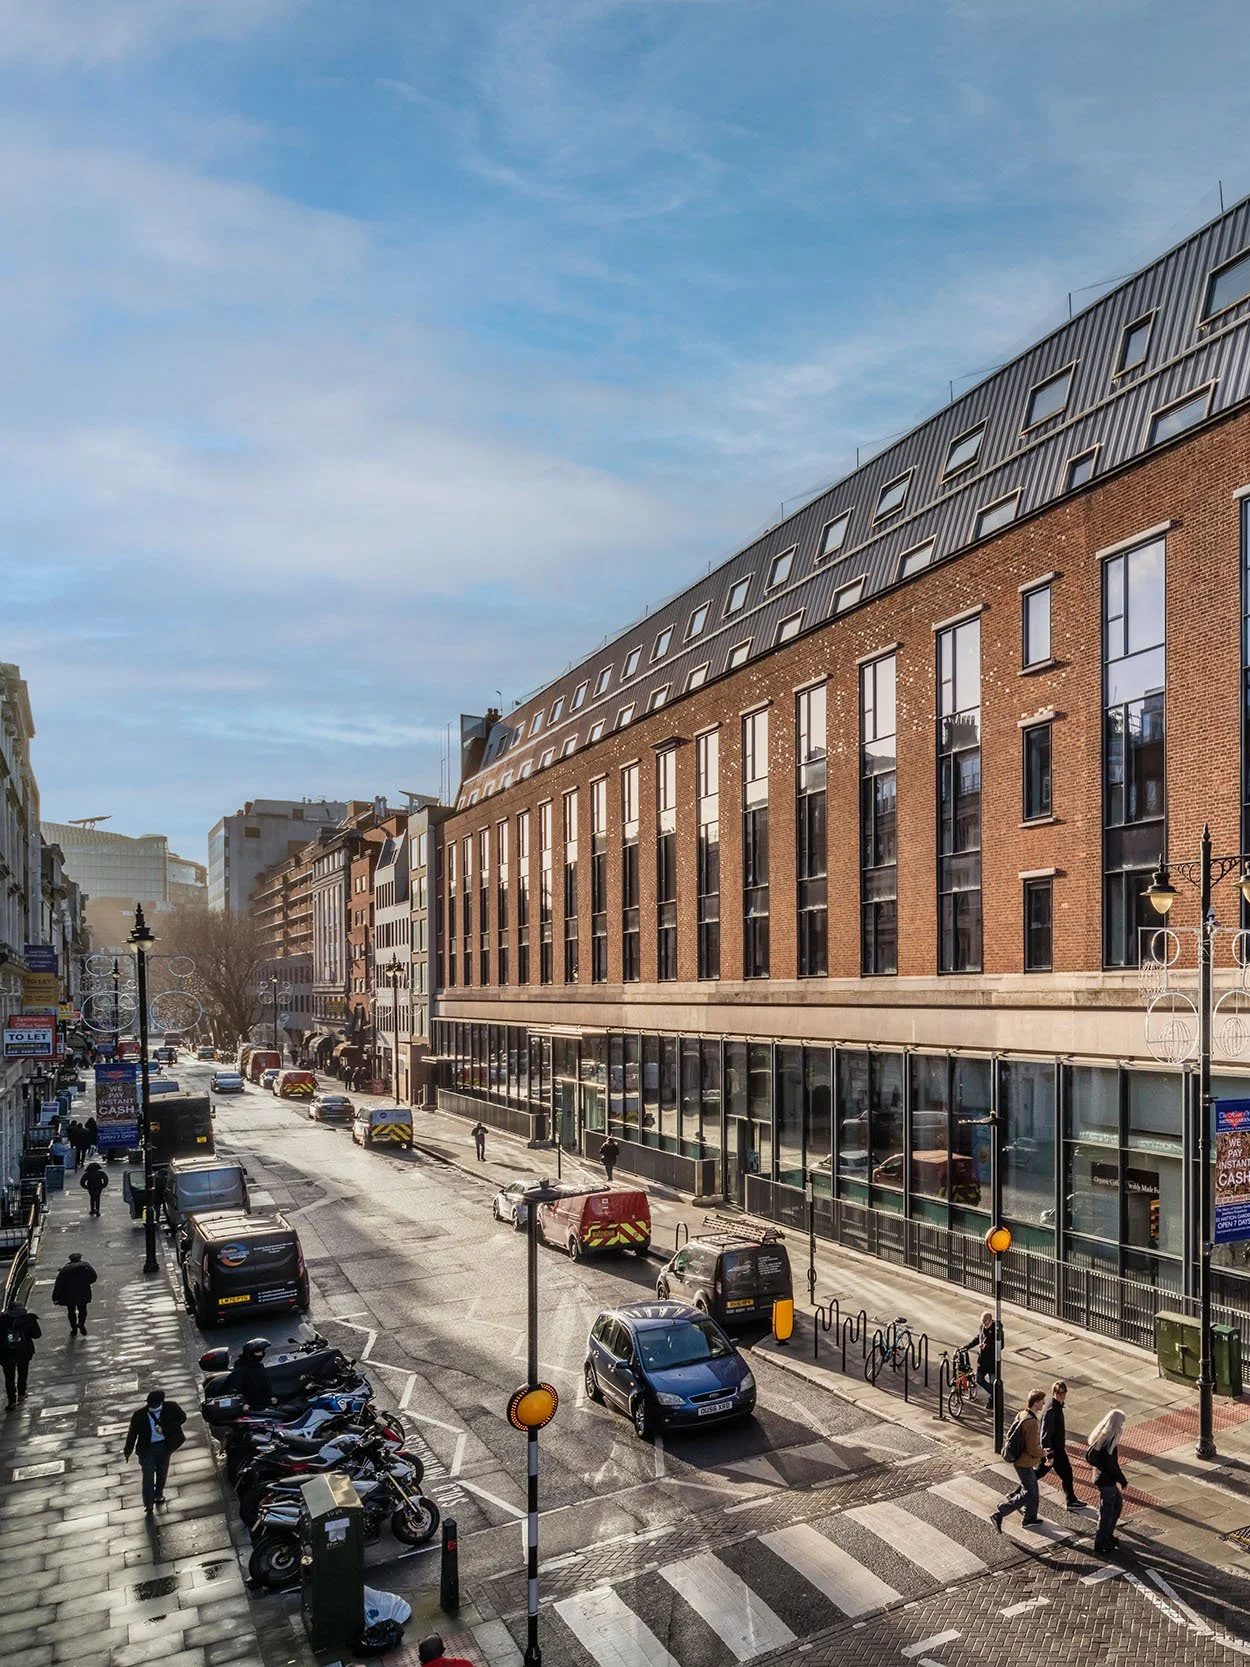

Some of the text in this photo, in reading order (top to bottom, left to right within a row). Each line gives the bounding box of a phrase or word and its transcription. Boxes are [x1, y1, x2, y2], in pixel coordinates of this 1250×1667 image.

[99, 1098, 133, 1106] INSTANT
[99, 1105, 135, 1115] CASH
[1228, 1138, 1242, 1147] WE
[1227, 1149, 1243, 1158] PAY
[1217, 1221, 1233, 1230] OPEN
